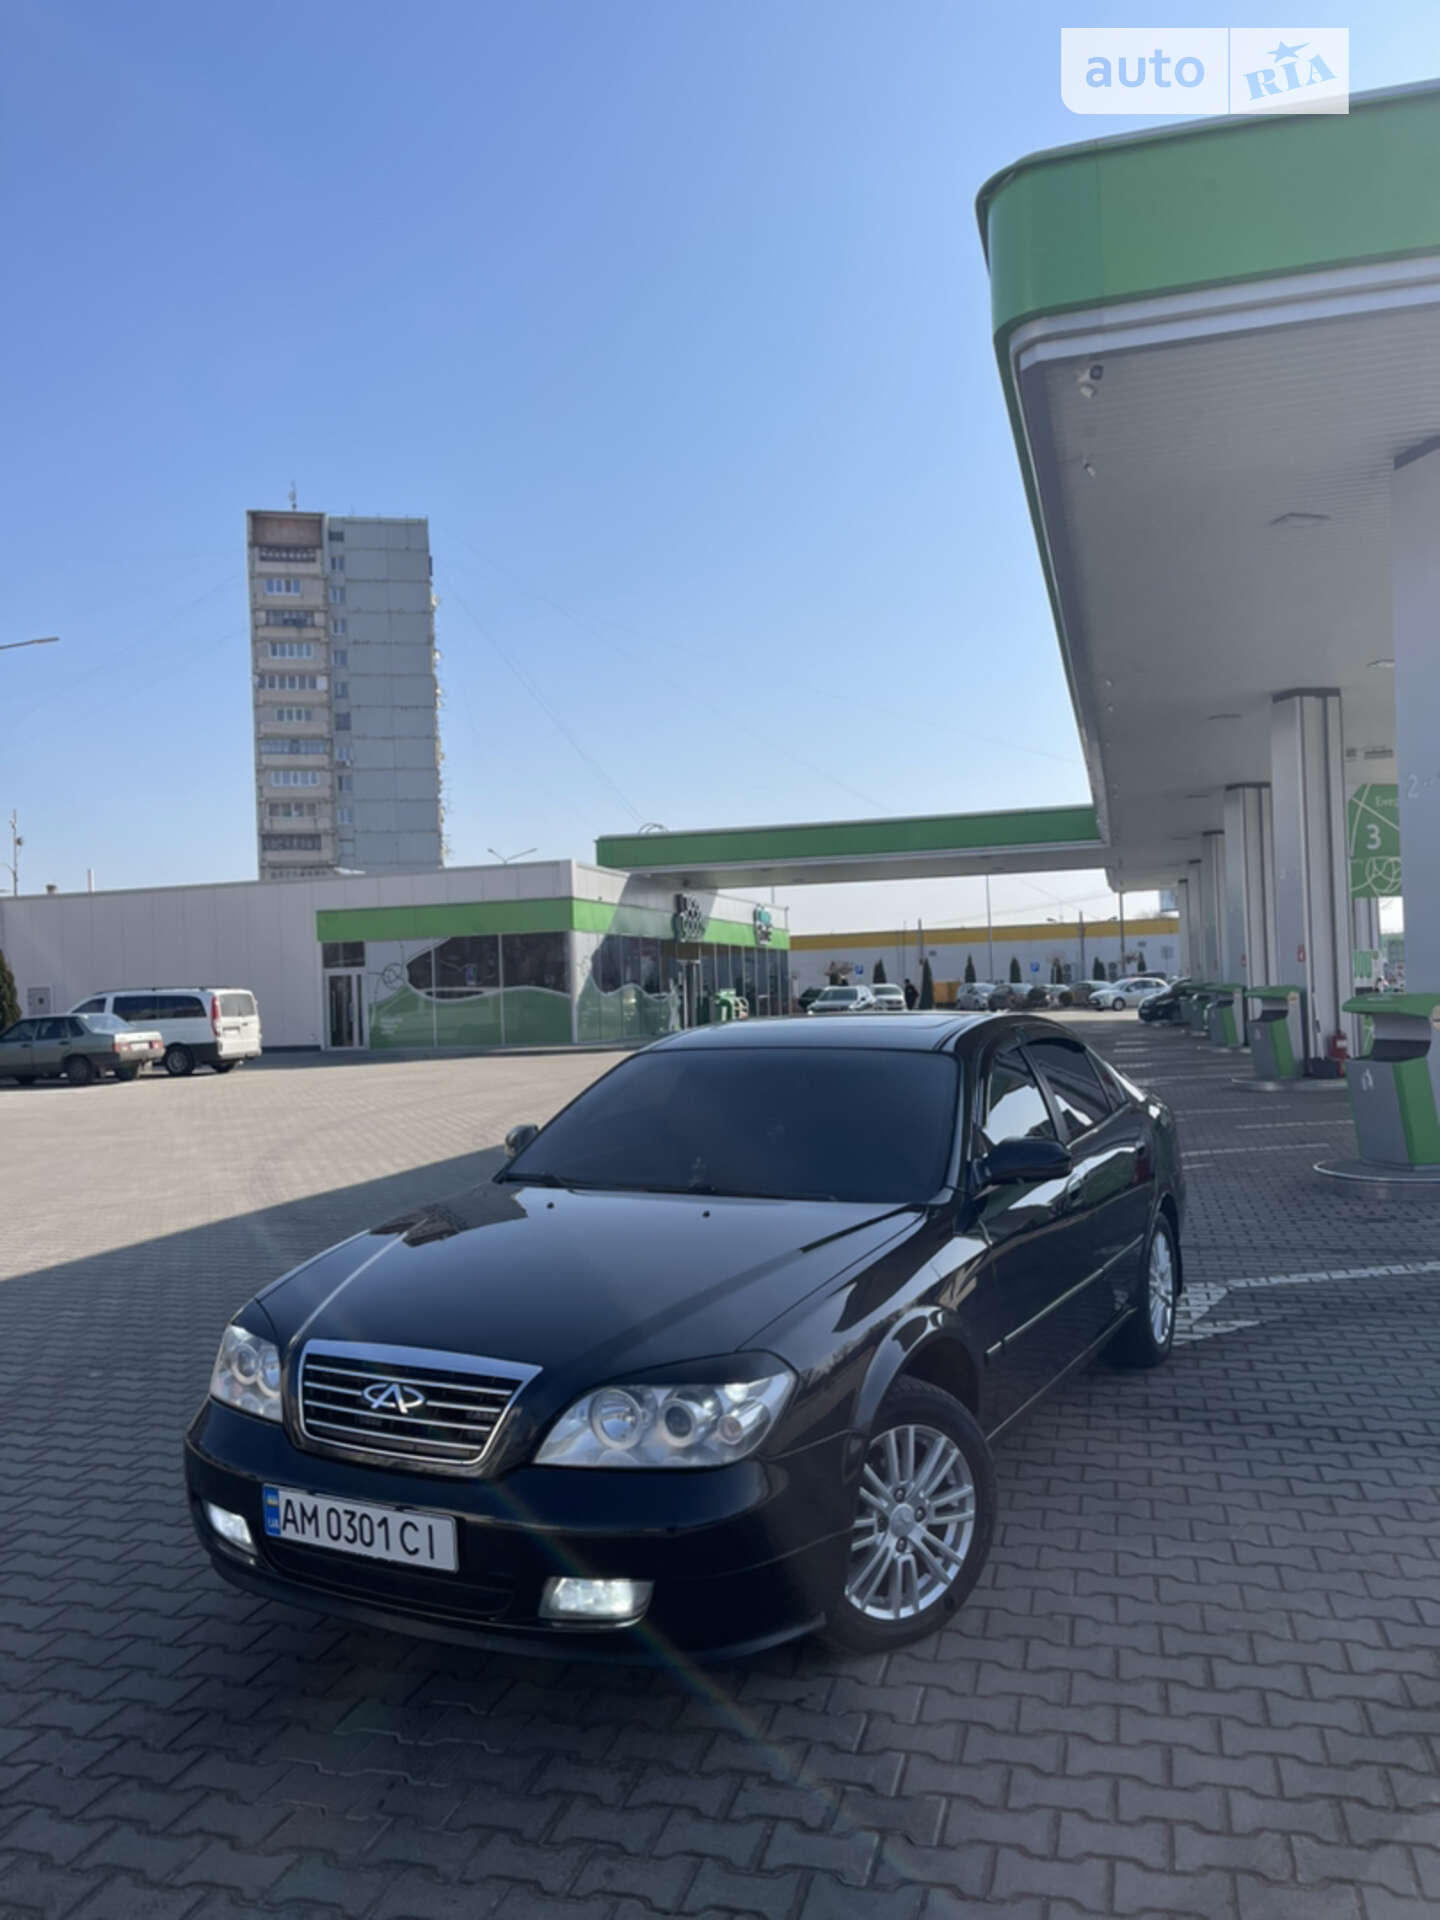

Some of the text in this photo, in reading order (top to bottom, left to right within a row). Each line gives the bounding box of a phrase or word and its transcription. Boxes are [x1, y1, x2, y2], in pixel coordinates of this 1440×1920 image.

[1407, 774, 1419, 798] 2
[1365, 824, 1382, 850] 3
[282, 1499, 320, 1538] AM
[326, 1507, 390, 1551] 0301
